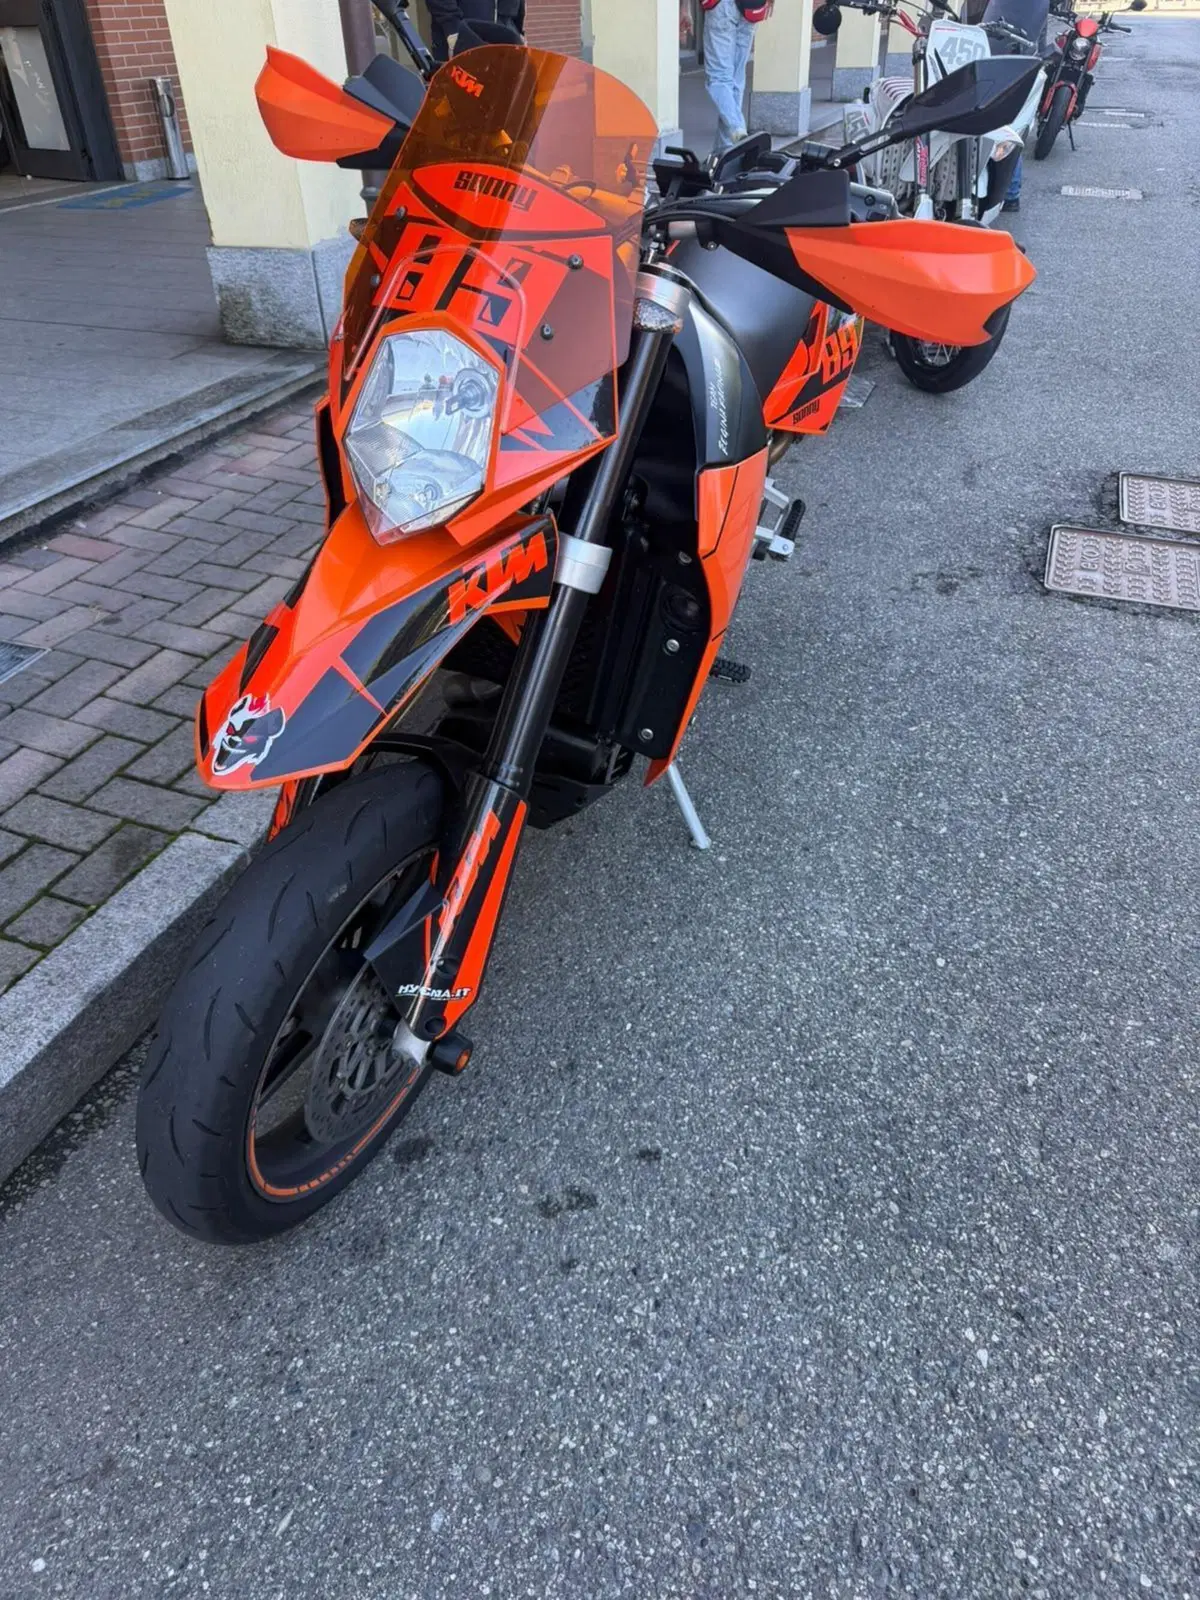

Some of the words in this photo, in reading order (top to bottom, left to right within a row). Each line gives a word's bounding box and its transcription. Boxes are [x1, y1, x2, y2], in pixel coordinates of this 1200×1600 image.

[940, 37, 986, 65] 450
[451, 65, 485, 98] KTM
[448, 531, 548, 625] KTM
